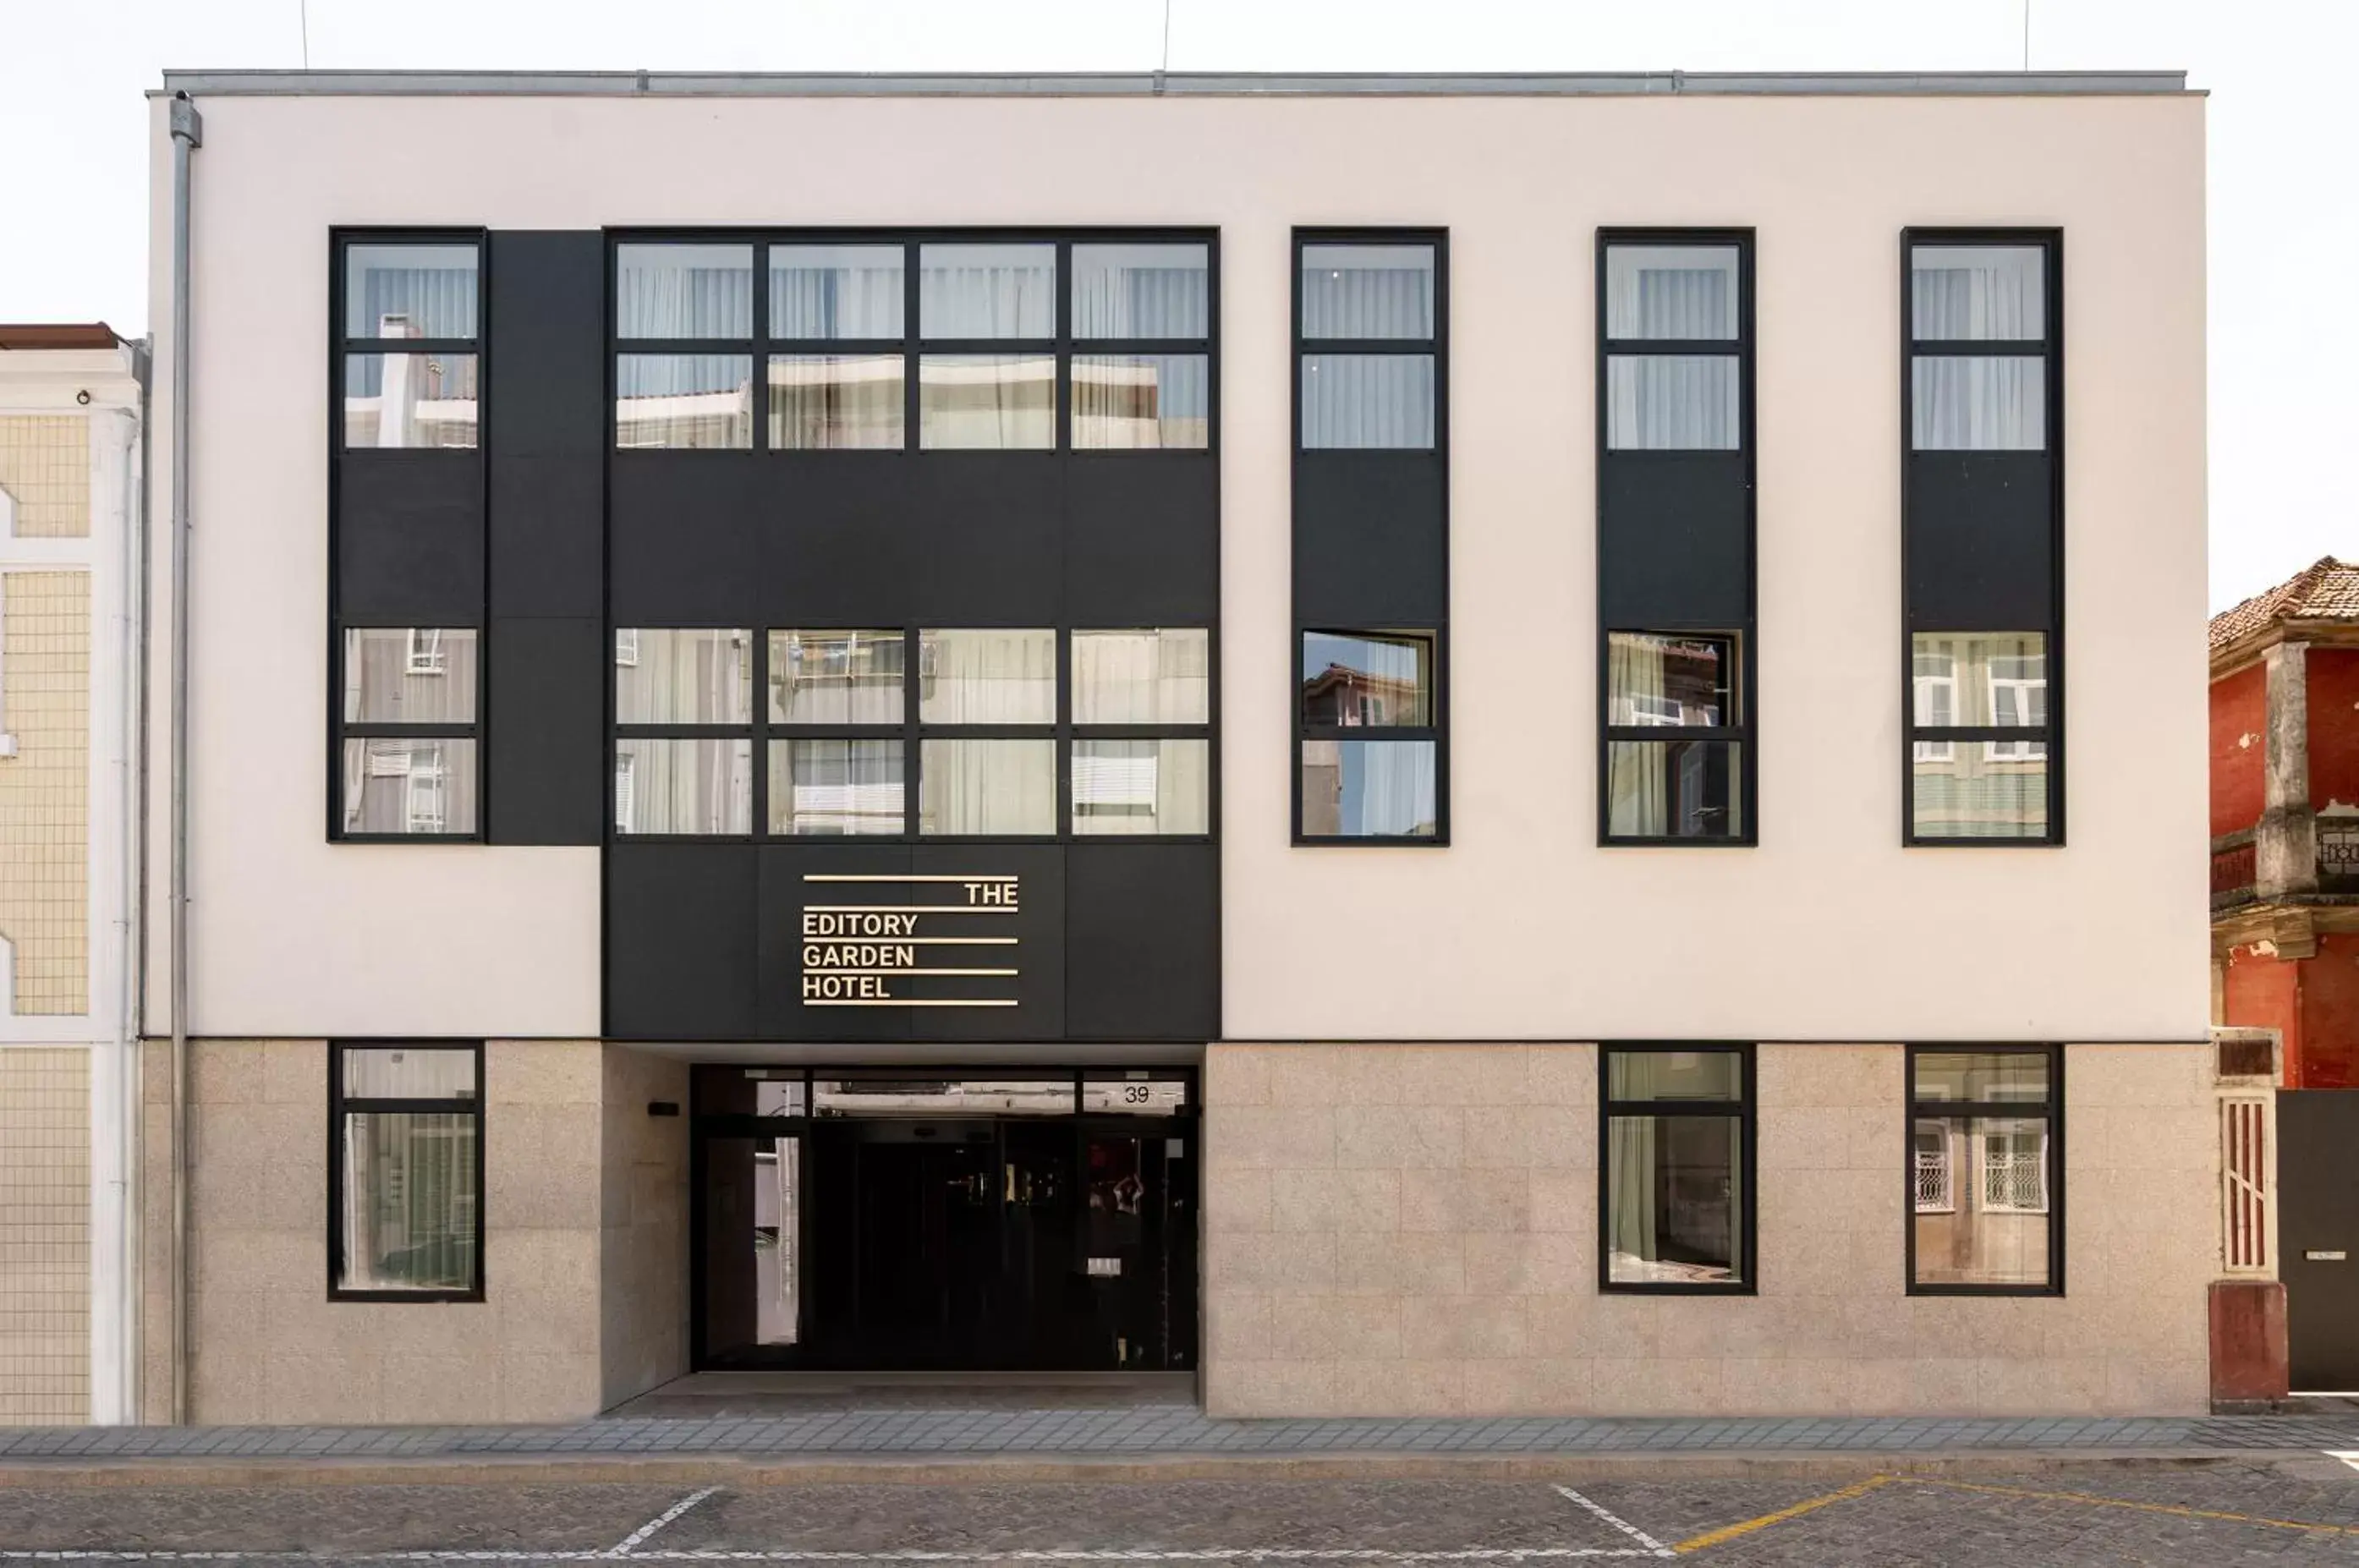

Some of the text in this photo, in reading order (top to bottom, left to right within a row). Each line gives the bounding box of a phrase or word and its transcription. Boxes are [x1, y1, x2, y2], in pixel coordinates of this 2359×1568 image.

[964, 883, 1018, 904] THE
[803, 913, 918, 935] EDITORY
[803, 945, 914, 966] GARDEN
[803, 976, 891, 997] HOTEL
[1125, 1086, 1149, 1104] 39
